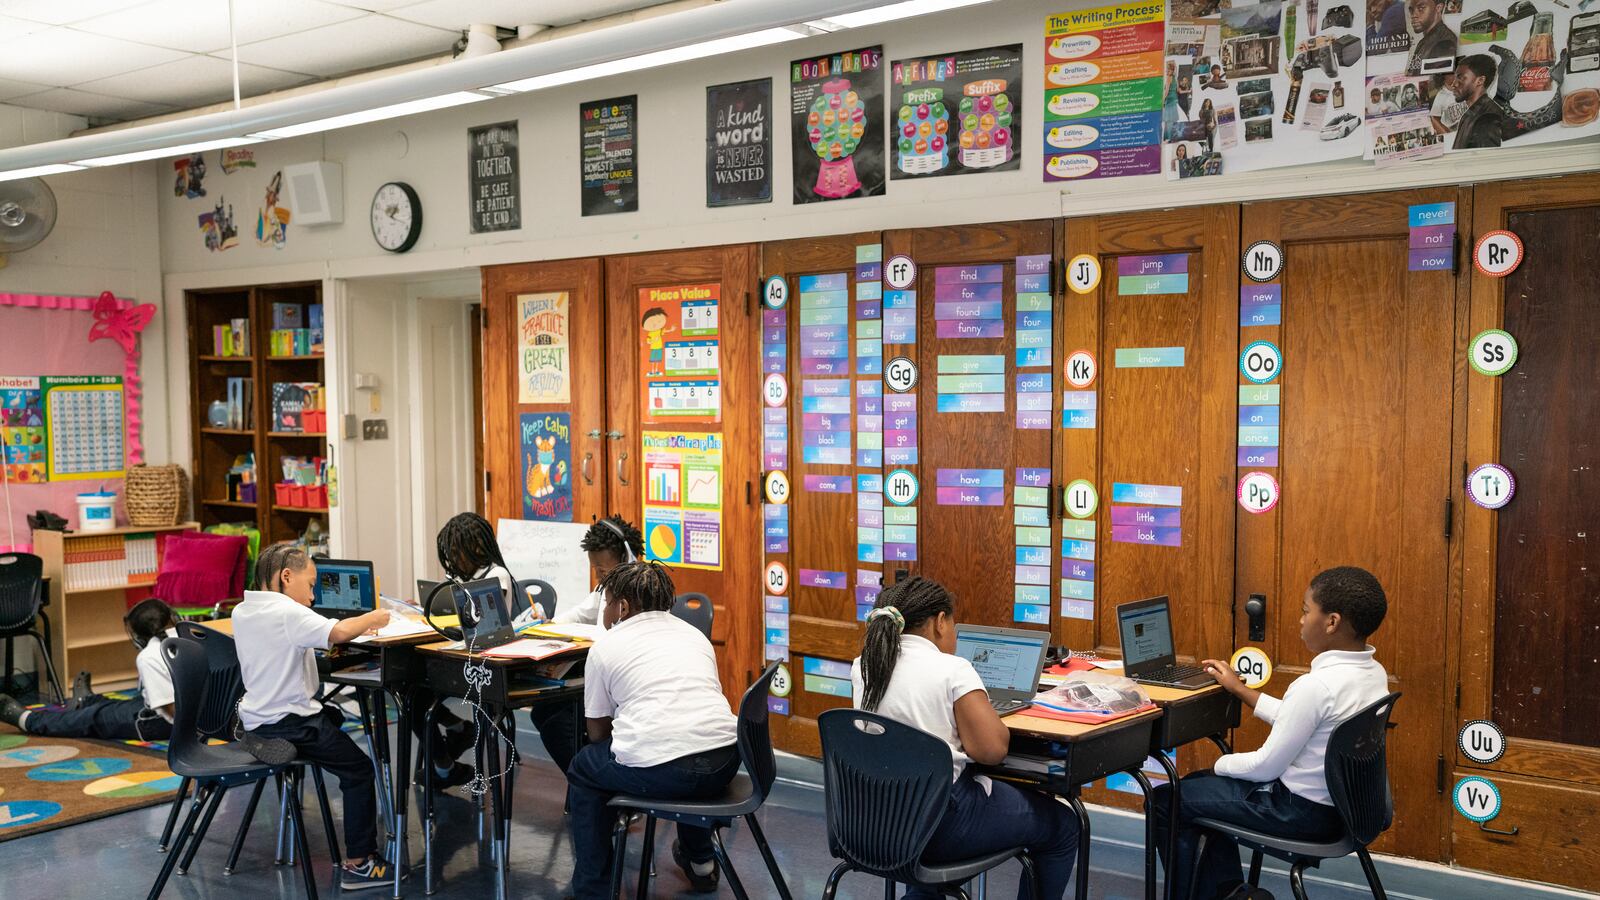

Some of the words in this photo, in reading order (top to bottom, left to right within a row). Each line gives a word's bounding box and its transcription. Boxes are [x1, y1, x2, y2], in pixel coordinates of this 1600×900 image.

[1050, 17, 1069, 29] The
[1071, 10, 1113, 25] Writing
[1115, 3, 1163, 19] Process:
[1390, 32, 1409, 41] AND
[794, 61, 827, 81] ROOT
[832, 52, 879, 73] WORDS
[895, 60, 953, 83] AFFIXES
[1064, 66, 1088, 75] Drafting
[1062, 96, 1087, 105] Revising
[584, 107, 600, 120] we
[716, 109, 726, 128] A
[727, 104, 764, 126] kind
[715, 123, 764, 147] word
[1063, 129, 1083, 138] Editing
[605, 148, 632, 158] TALENTED
[726, 144, 764, 169] NEVER
[476, 157, 512, 178] TOGETHER
[584, 160, 609, 173] HONEST
[1060, 158, 1089, 167] Publishing
[610, 169, 633, 180] UNIQUE
[715, 168, 765, 184] WASTED
[481, 185, 489, 198] BE
[492, 182, 509, 196] SAFE
[476, 199, 485, 213] BE
[487, 195, 515, 211] PATIENT
[482, 213, 491, 226] BE
[493, 210, 510, 225] KIND
[1418, 208, 1449, 220] never
[1425, 232, 1445, 244] not
[1487, 242, 1510, 266] Rr
[1026, 260, 1044, 270] first
[1139, 259, 1164, 275] jump
[1253, 250, 1274, 272] Nn
[1421, 256, 1446, 268] now
[861, 269, 874, 278] and
[892, 263, 908, 282] Ff
[960, 270, 978, 281] find
[1076, 262, 1090, 286] Jj
[1024, 279, 1040, 290] five
[649, 289, 680, 302] Place
[680, 287, 711, 300] Value
[770, 284, 783, 300] Aa
[961, 288, 975, 299] for
[1252, 292, 1274, 302] new
[893, 295, 907, 305] fall
[1030, 296, 1043, 308] fly
[522, 299, 550, 320] WHEN
[688, 308, 694, 318] 8
[706, 307, 712, 317] 6
[863, 308, 875, 316] are
[955, 306, 981, 317] found
[1023, 316, 1041, 327] four
[1252, 314, 1265, 322] no
[522, 312, 565, 340] PRACTICE
[958, 322, 982, 336] funny
[813, 329, 834, 341] always
[889, 330, 906, 340] fast
[1021, 335, 1043, 345] from
[672, 348, 677, 358] 3
[689, 348, 694, 358] 8
[707, 347, 712, 357] 6
[812, 348, 836, 356] around
[1026, 350, 1041, 361] full
[1137, 352, 1161, 364] know
[1482, 341, 1505, 364] Ss
[523, 347, 565, 374] GREAT
[1247, 352, 1275, 373] Oo
[816, 363, 833, 373] away
[1072, 359, 1090, 380] Kk
[46, 376, 89, 384] Numbers
[890, 364, 912, 385] Gg
[769, 382, 783, 398] Bb
[1021, 378, 1044, 392] good
[672, 388, 678, 398] 3
[690, 387, 695, 397] 8
[707, 386, 713, 397] 6
[865, 403, 876, 412] but
[891, 401, 912, 411] gave
[821, 415, 832, 430] big
[895, 417, 908, 430] get
[1022, 416, 1048, 429] green
[1070, 412, 1090, 426] keep
[1250, 414, 1264, 423] on
[521, 419, 544, 445] Keep
[544, 416, 569, 444] Calm
[677, 434, 721, 451] Graphs
[818, 434, 835, 445] black
[896, 435, 908, 447] go
[1244, 433, 1269, 443] once
[863, 454, 873, 464] be
[890, 453, 910, 464] goes
[1247, 455, 1265, 463] one
[960, 473, 981, 485] have
[1022, 470, 1041, 486] help
[771, 479, 785, 495] Cc
[819, 481, 837, 490] come
[894, 478, 910, 497] Hh
[1480, 474, 1501, 497] Tt
[960, 490, 980, 502] here
[1075, 490, 1087, 509] Ll
[1135, 487, 1159, 504] laugh
[1249, 482, 1271, 508] Pp
[893, 512, 911, 522] had
[1136, 511, 1156, 523] little
[1137, 529, 1156, 542] look
[896, 548, 908, 558] he
[1025, 551, 1044, 562] hold
[1072, 566, 1087, 577] like
[770, 570, 783, 586] Dd
[814, 573, 832, 585] down
[864, 591, 876, 603] did
[1022, 591, 1040, 601] how
[1024, 609, 1043, 620] hurt
[1236, 655, 1264, 681] Qq
[1470, 729, 1494, 753] Uu
[1466, 786, 1490, 811] Vv
